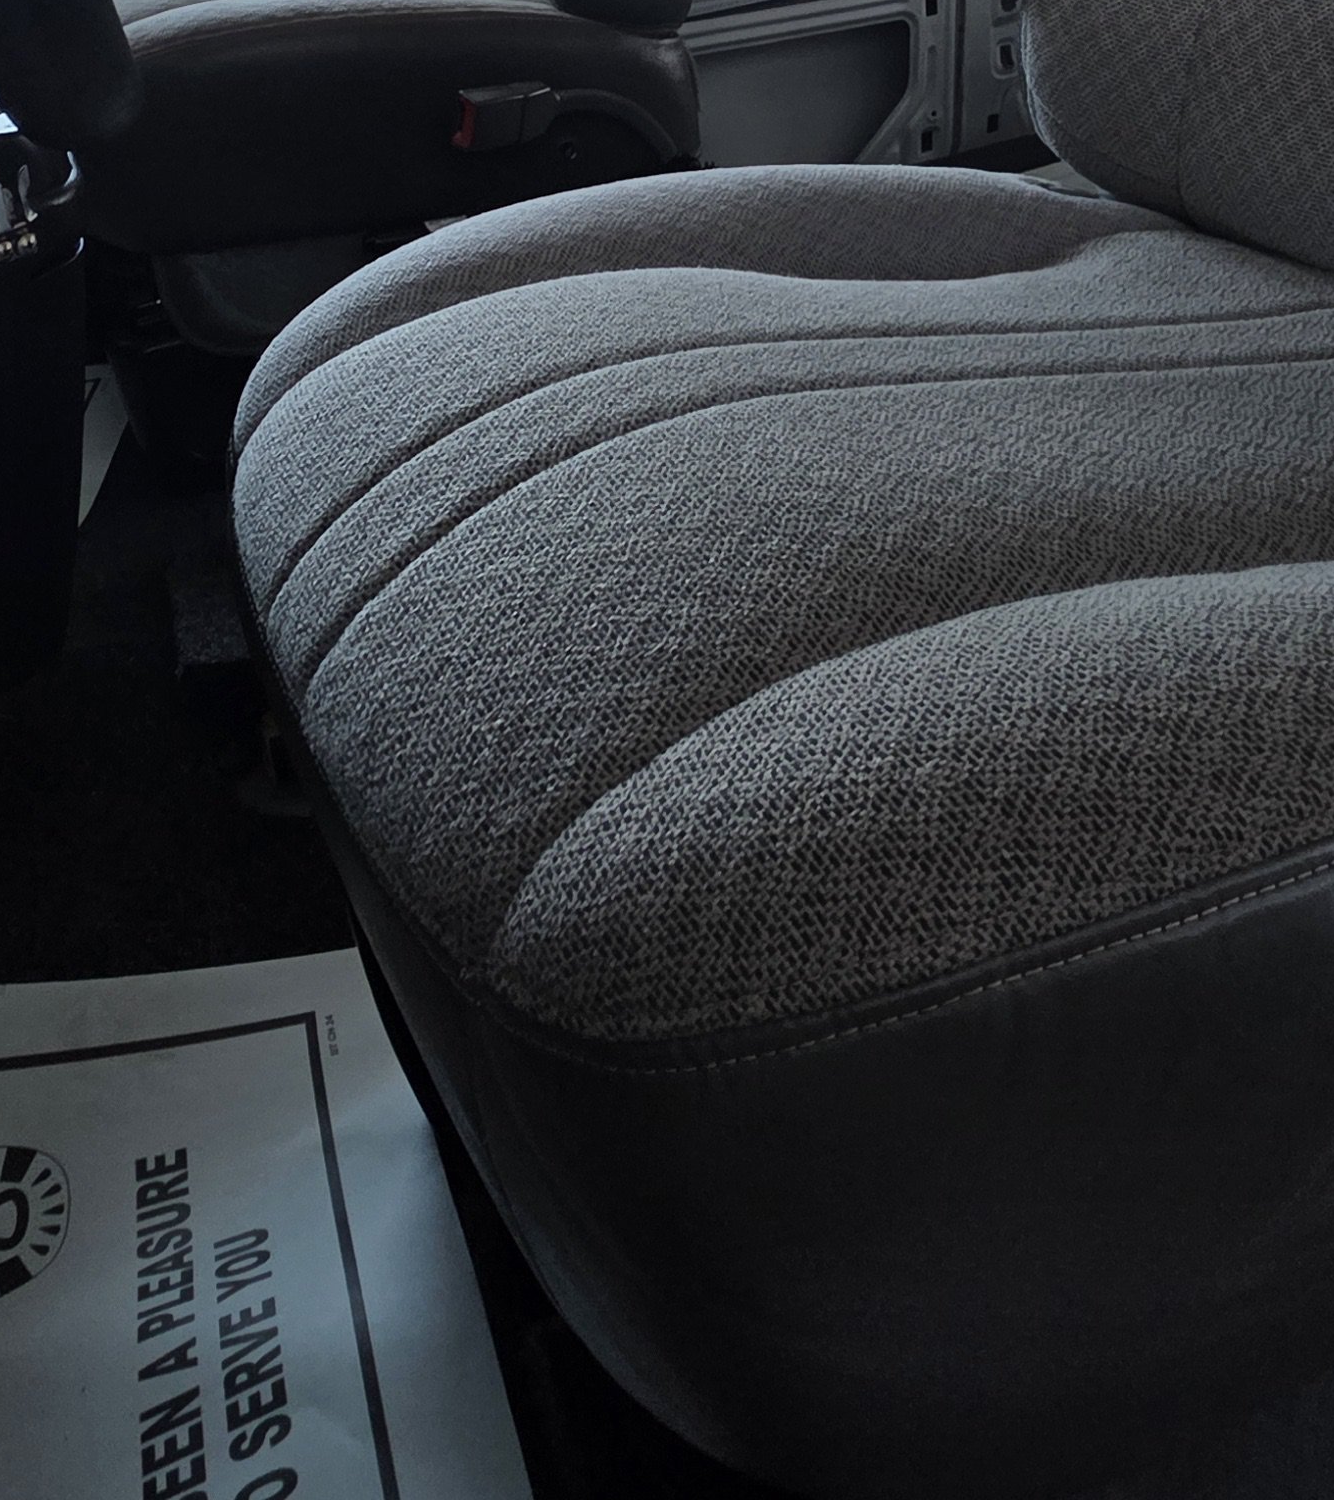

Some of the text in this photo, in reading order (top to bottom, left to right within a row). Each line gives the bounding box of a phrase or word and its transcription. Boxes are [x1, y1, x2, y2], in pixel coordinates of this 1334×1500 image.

[134, 1147, 209, 1500] EEN A PLEASURE
[213, 1228, 273, 1304] YOU
[218, 1297, 293, 1462] SERVE
